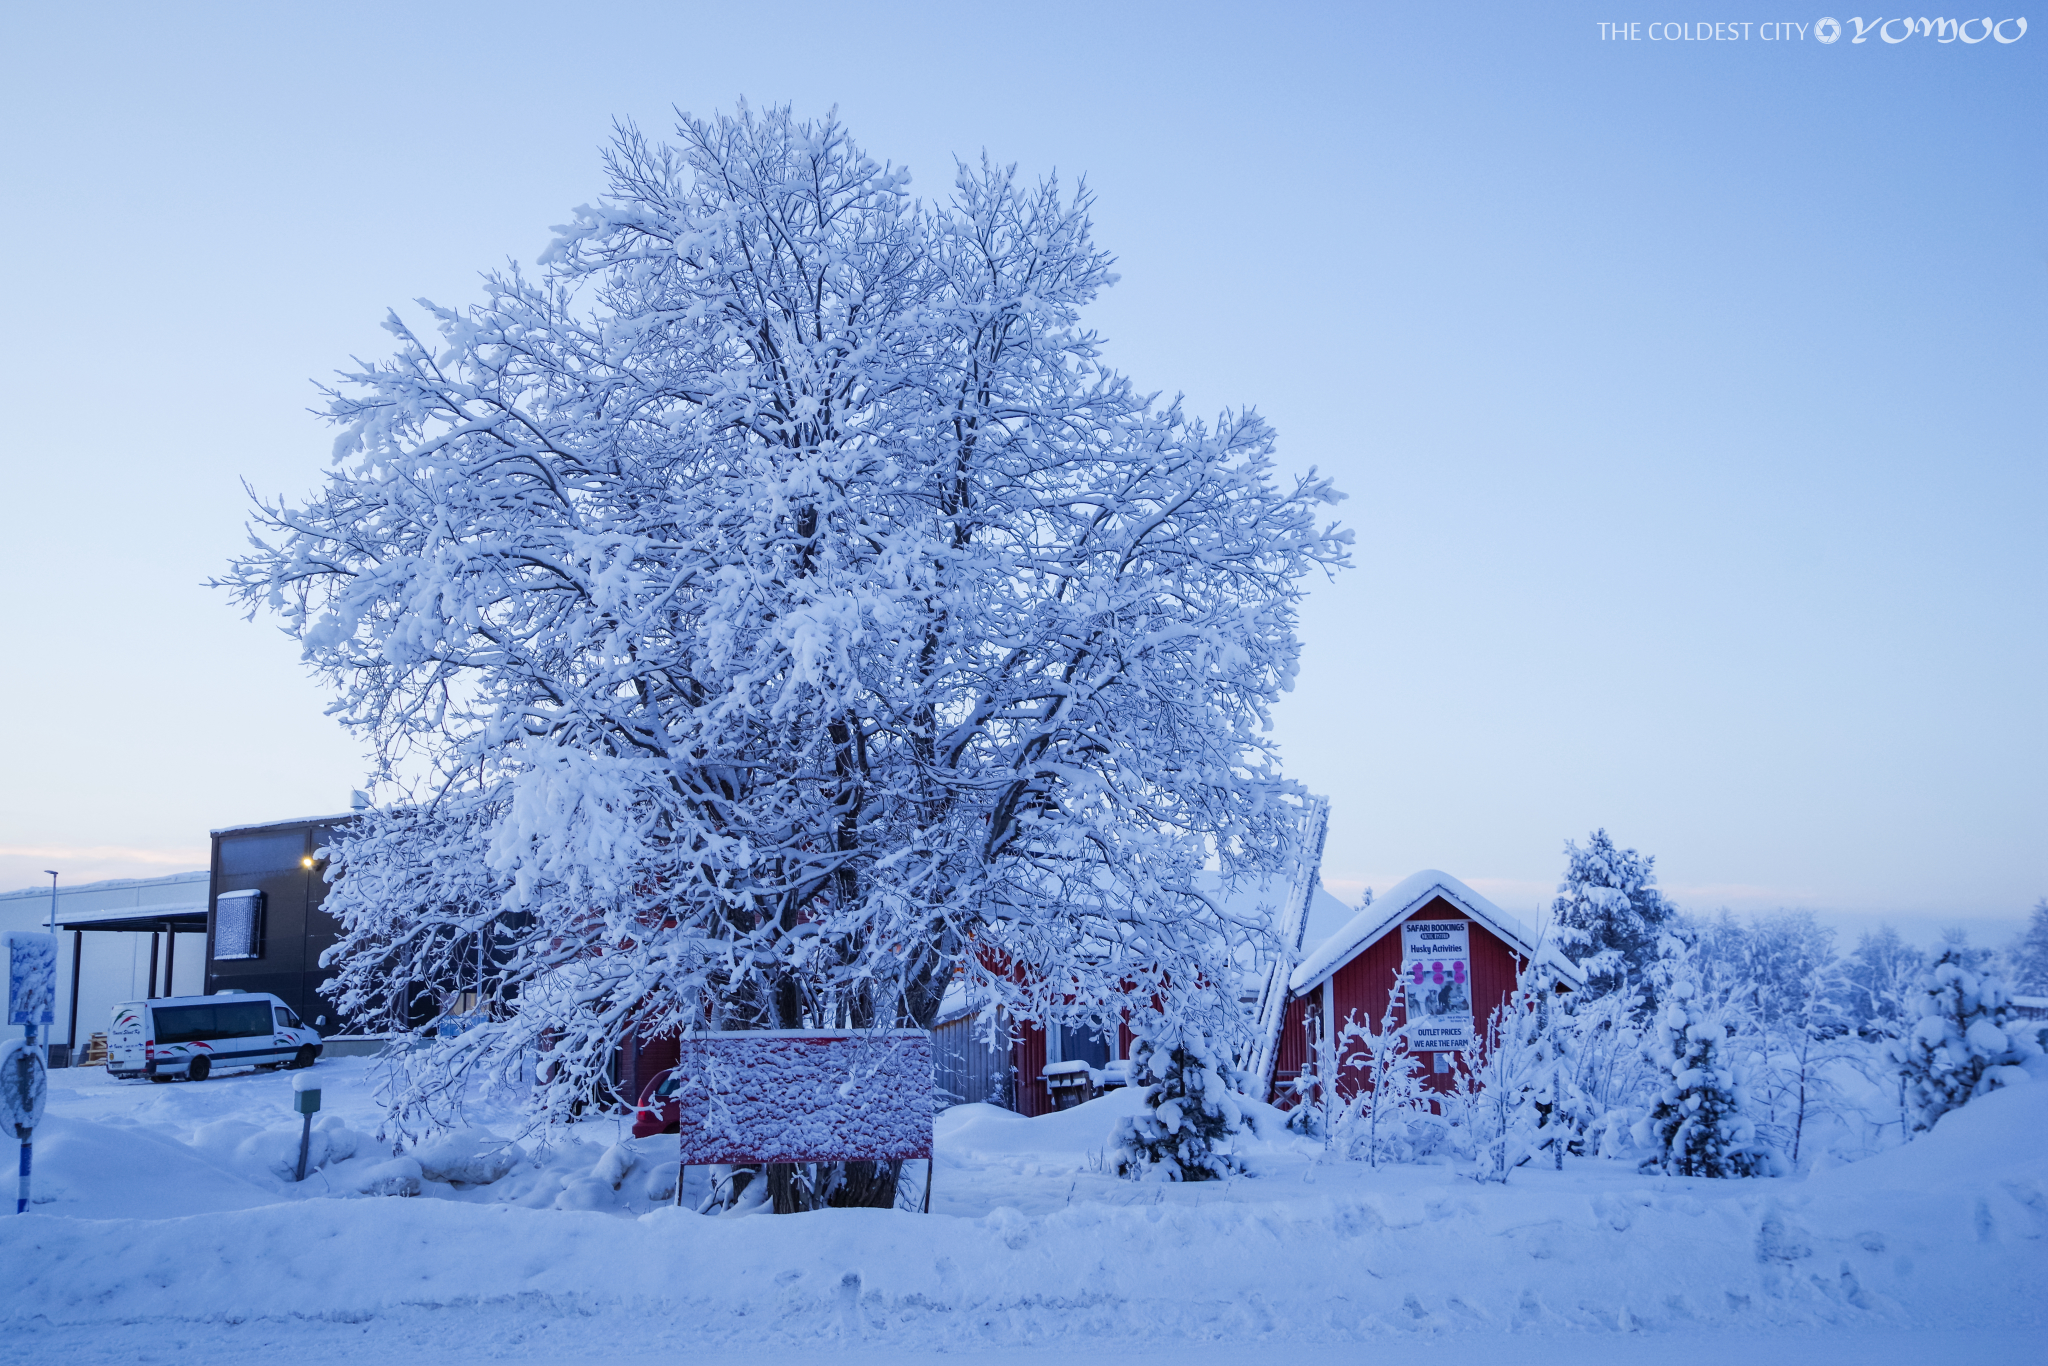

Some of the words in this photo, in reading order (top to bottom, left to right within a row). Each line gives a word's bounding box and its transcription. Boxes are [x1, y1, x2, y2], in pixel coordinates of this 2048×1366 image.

[1406, 924, 1430, 932] SAFARI
[1431, 923, 1465, 932] BOOKINGS
[1410, 944, 1431, 954] Husky
[1432, 944, 1462, 952] Activities
[1418, 1028, 1440, 1036] OUTLET
[1440, 1028, 1462, 1036] PRICES
[1413, 1040, 1424, 1048] WE
[1450, 1039, 1469, 1047] FARM
